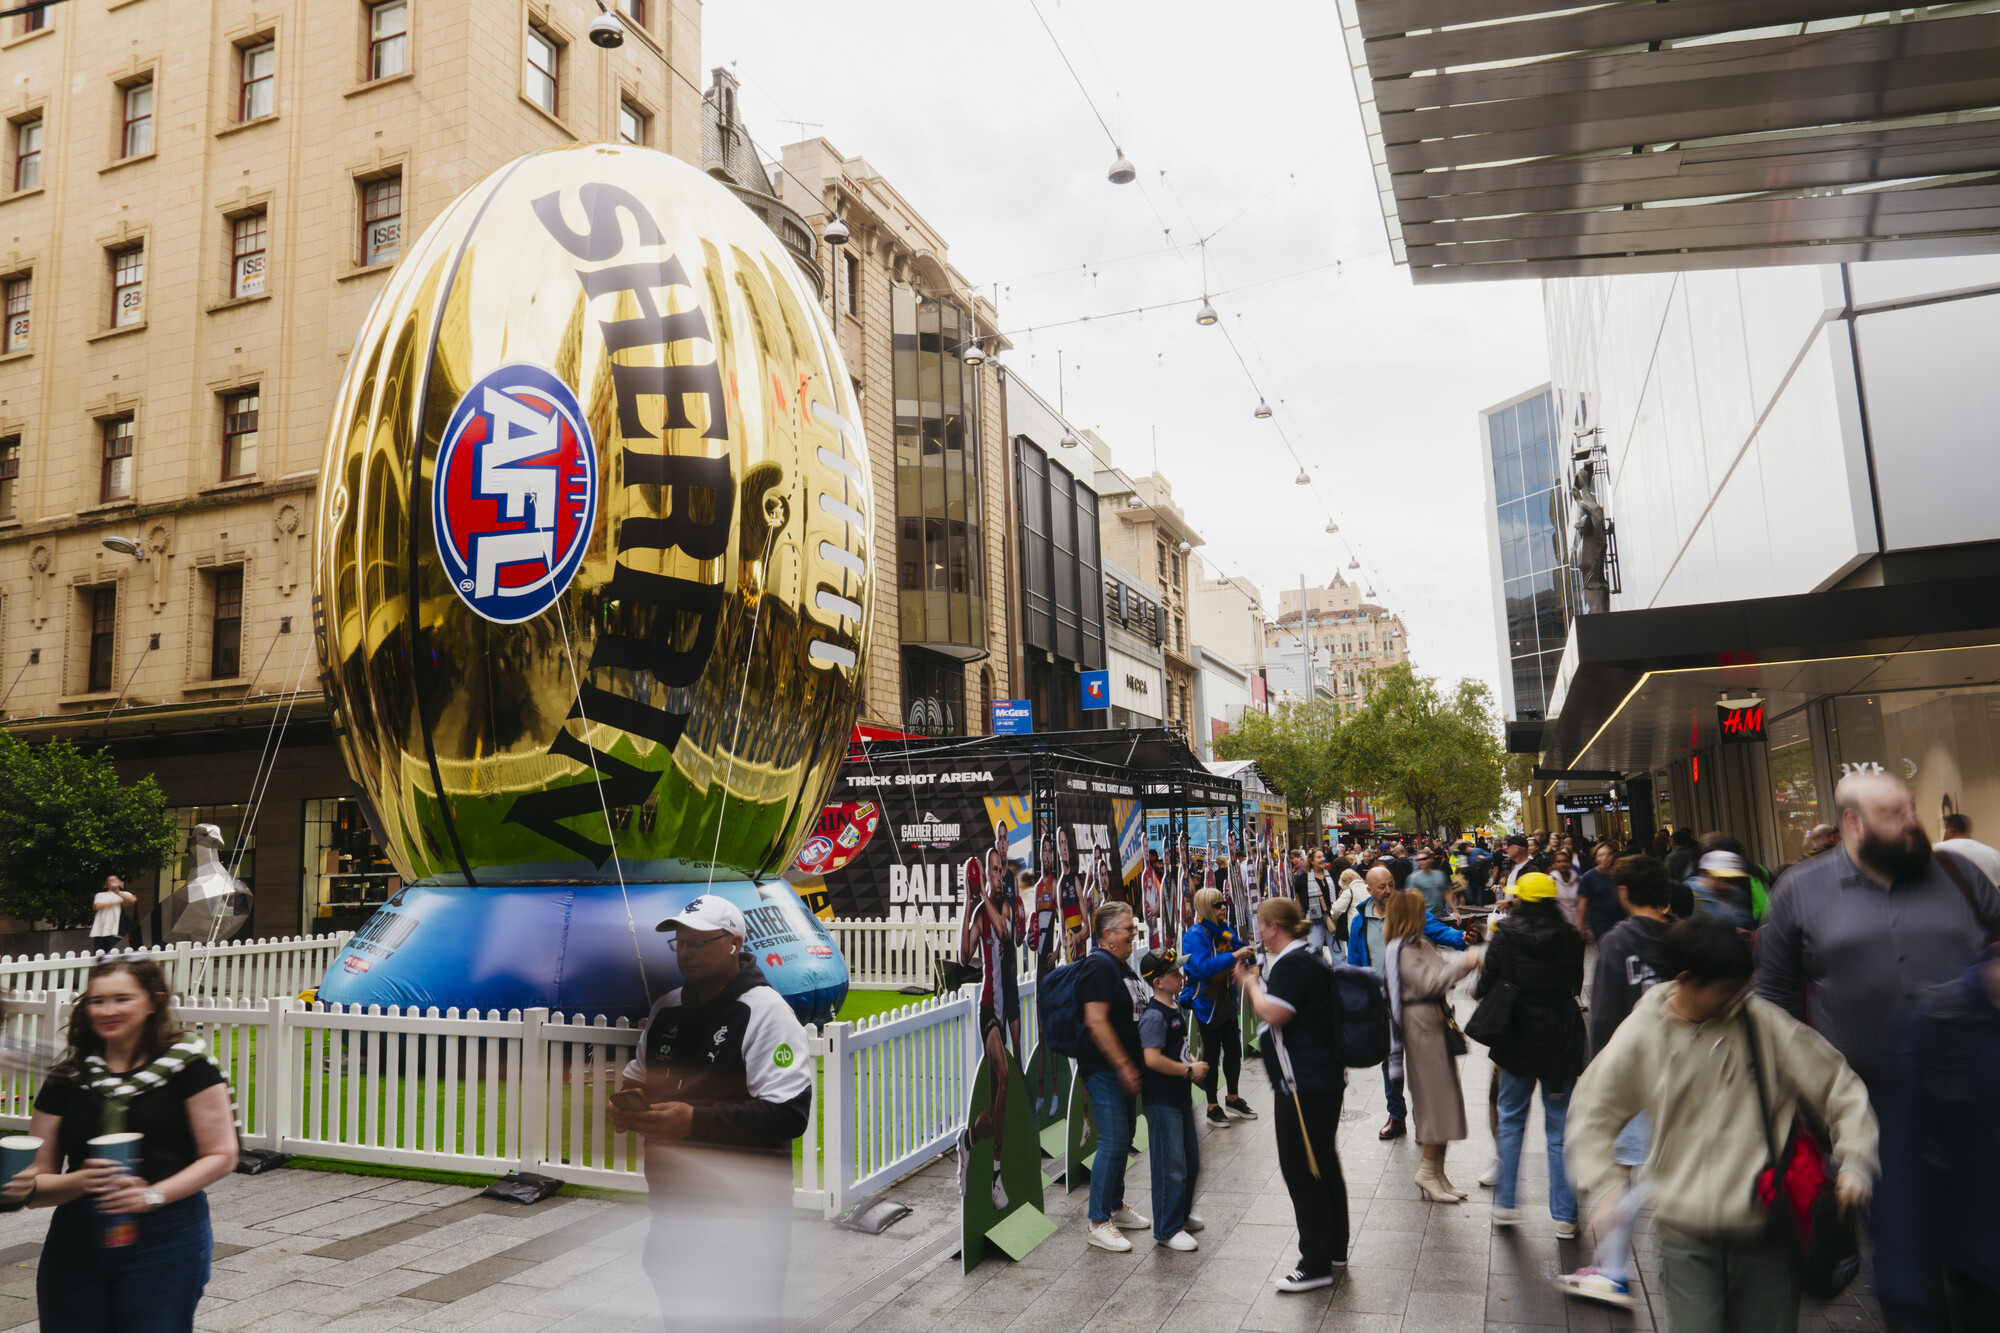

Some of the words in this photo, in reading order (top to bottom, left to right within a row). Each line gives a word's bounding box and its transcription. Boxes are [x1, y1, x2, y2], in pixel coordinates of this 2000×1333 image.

[474, 386, 559, 599] AFL
[502, 182, 731, 870] SHERRIN
[1126, 674, 1148, 695] MECCA
[995, 709, 1029, 717] McGEES
[1723, 707, 1762, 734] H&M
[846, 776, 892, 787] TRICK
[895, 773, 937, 785] SHOT
[940, 771, 994, 783] ARENA
[1091, 781, 1107, 792] TRICK
[1107, 784, 1119, 793] SHOT
[901, 824, 932, 838] GATHER
[932, 824, 960, 837] ROUND
[803, 840, 832, 863] AFL
[890, 863, 955, 903] BALL
[752, 934, 801, 951] FESTIVAL
[782, 953, 799, 963] SOUTH
